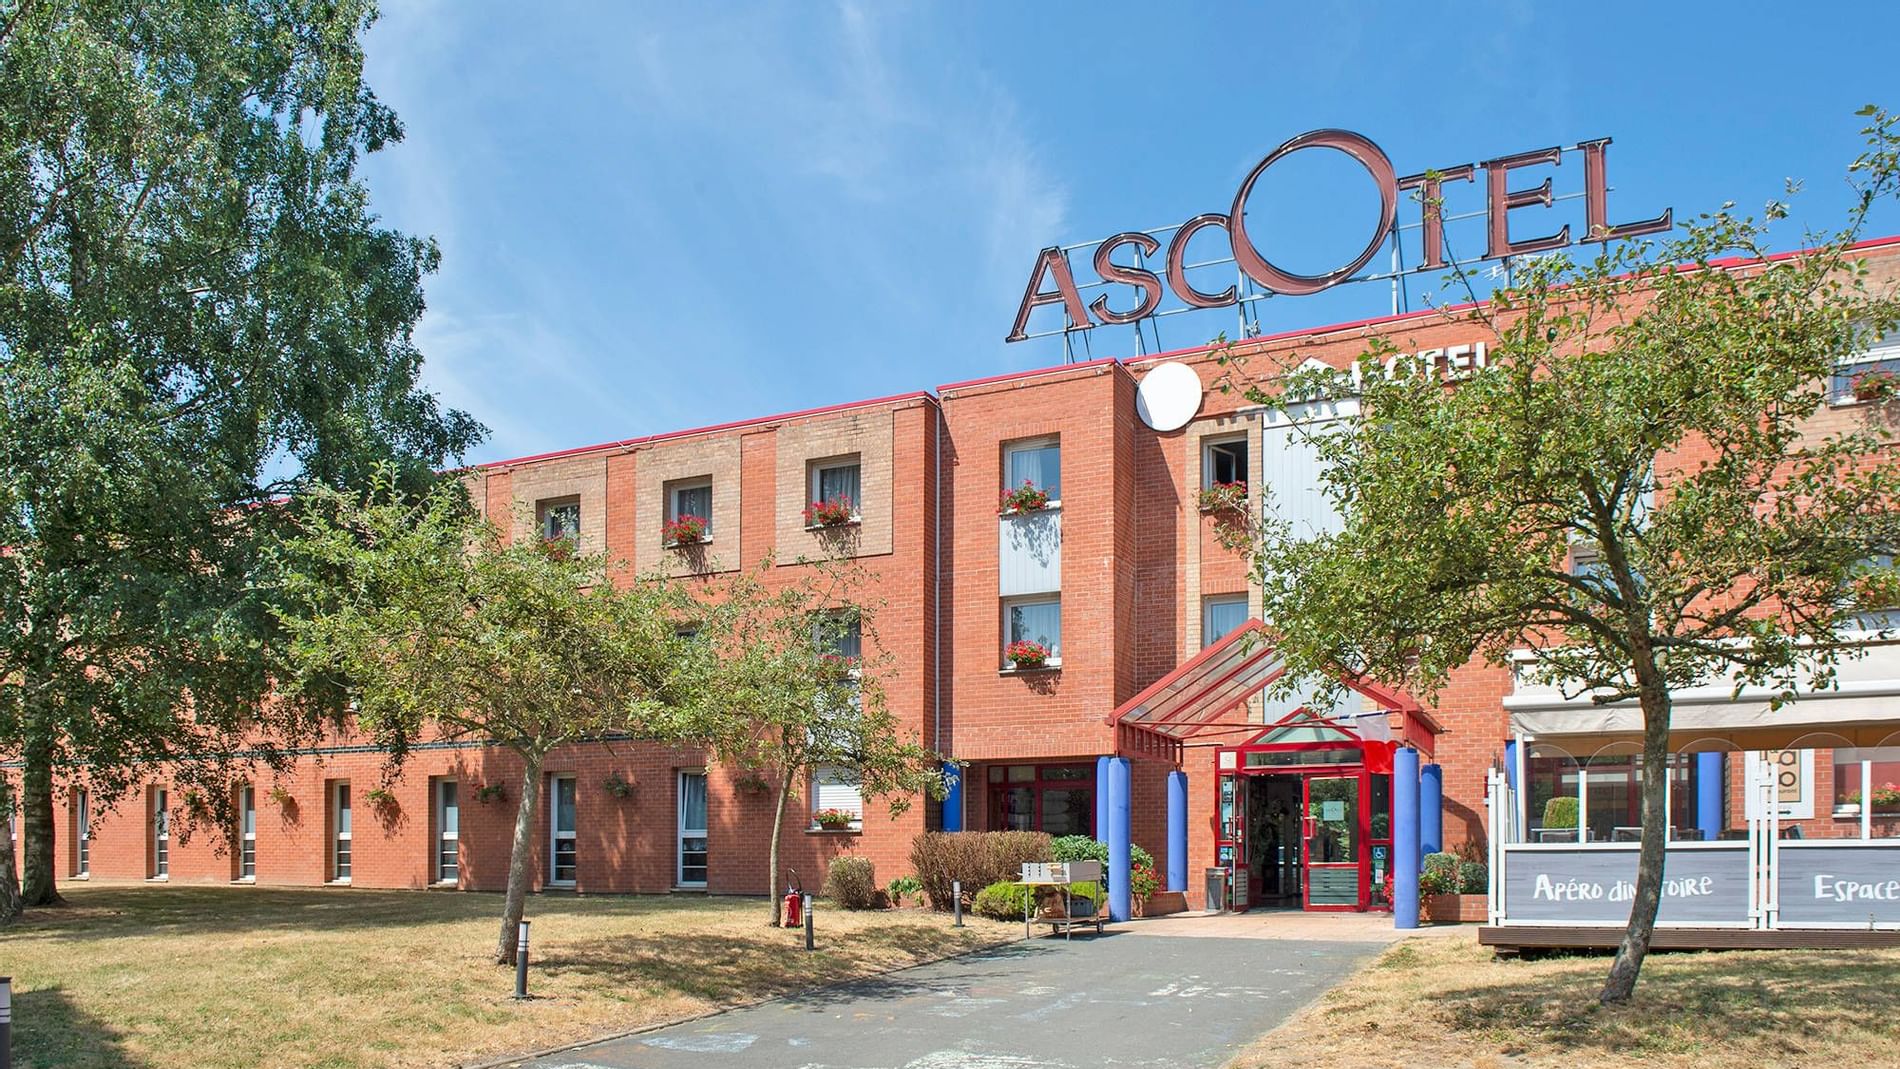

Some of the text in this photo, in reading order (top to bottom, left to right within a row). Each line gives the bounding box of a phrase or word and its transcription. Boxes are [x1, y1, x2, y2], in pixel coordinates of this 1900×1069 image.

[1005, 128, 1672, 343] ASCOTEL
[1533, 873, 1713, 902] Apéro dintoire
[1814, 874, 1900, 902] Espace
